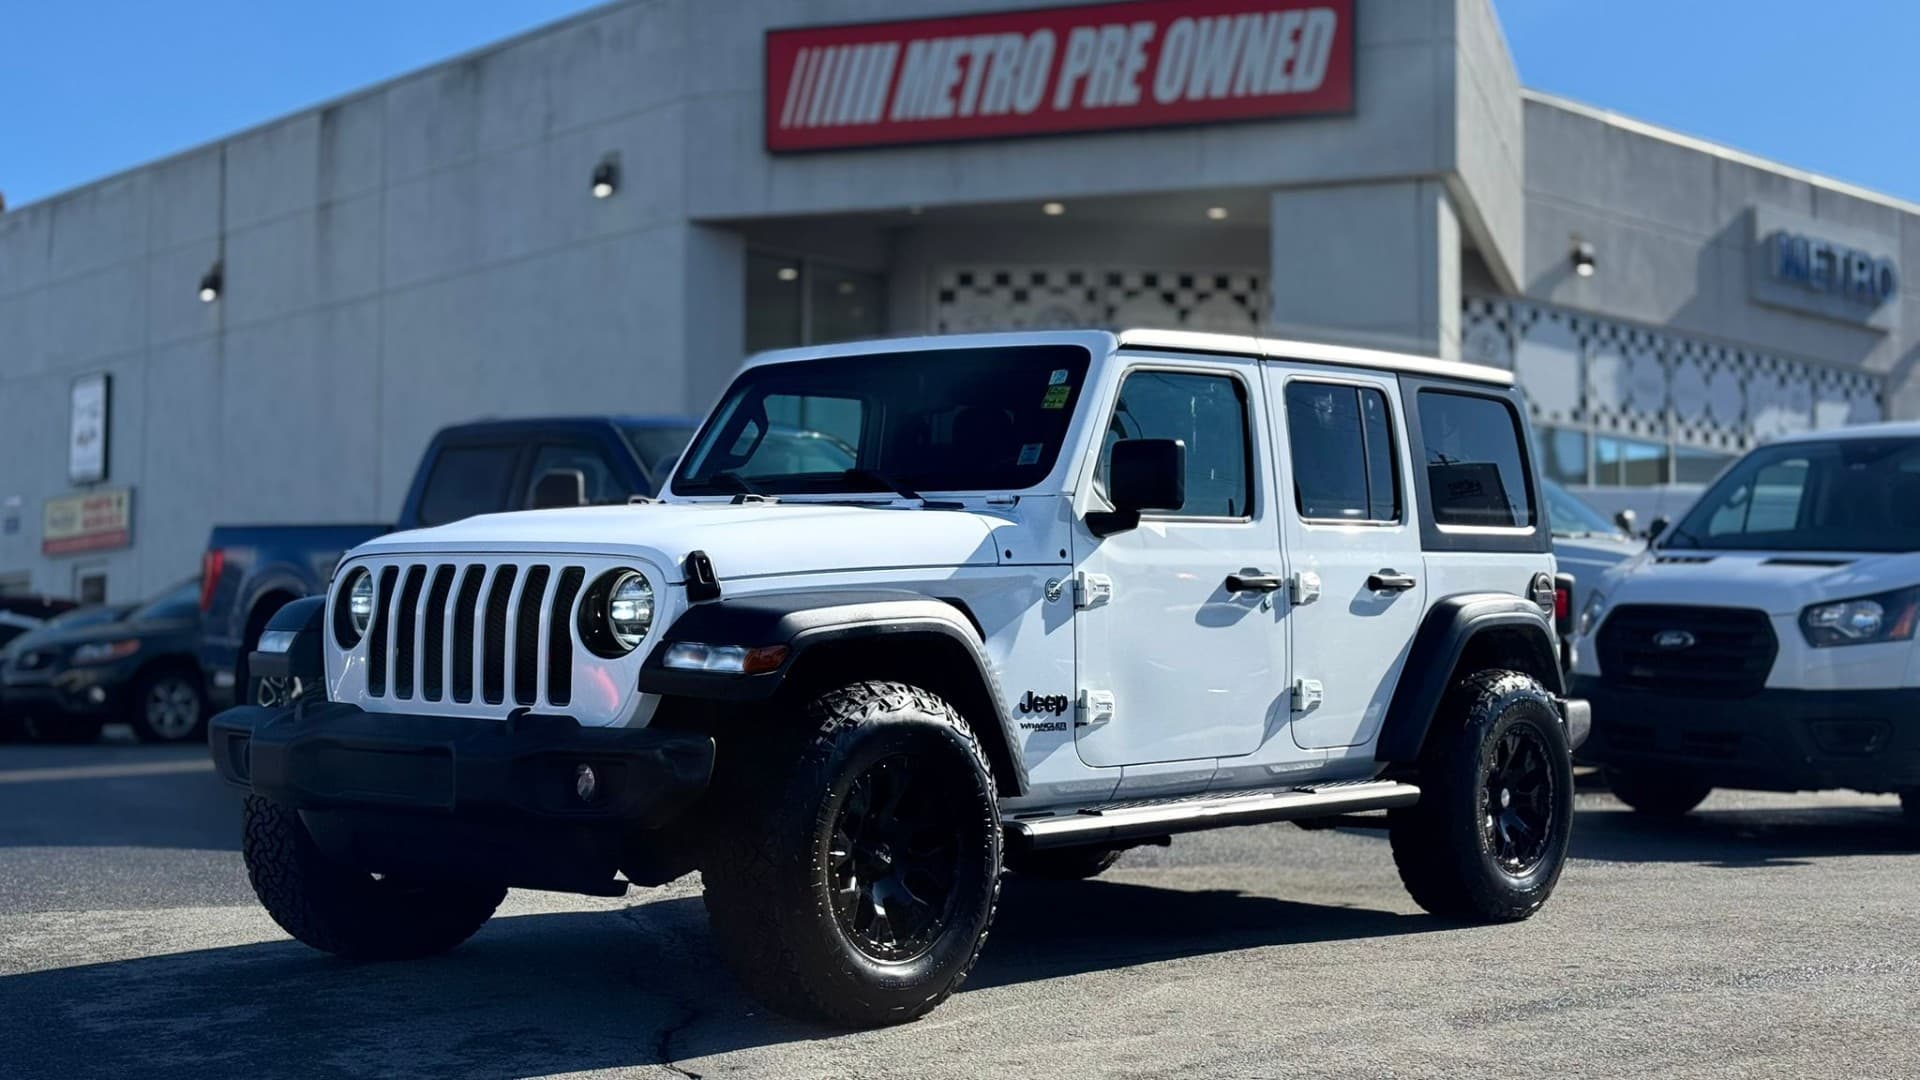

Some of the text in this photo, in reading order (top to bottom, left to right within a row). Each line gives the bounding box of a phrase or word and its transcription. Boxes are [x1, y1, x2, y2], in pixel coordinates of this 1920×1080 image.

[891, 8, 1337, 122] METRO PRE OWNED
[1779, 232, 1898, 304] METRO
[1020, 690, 1068, 717] Jeep
